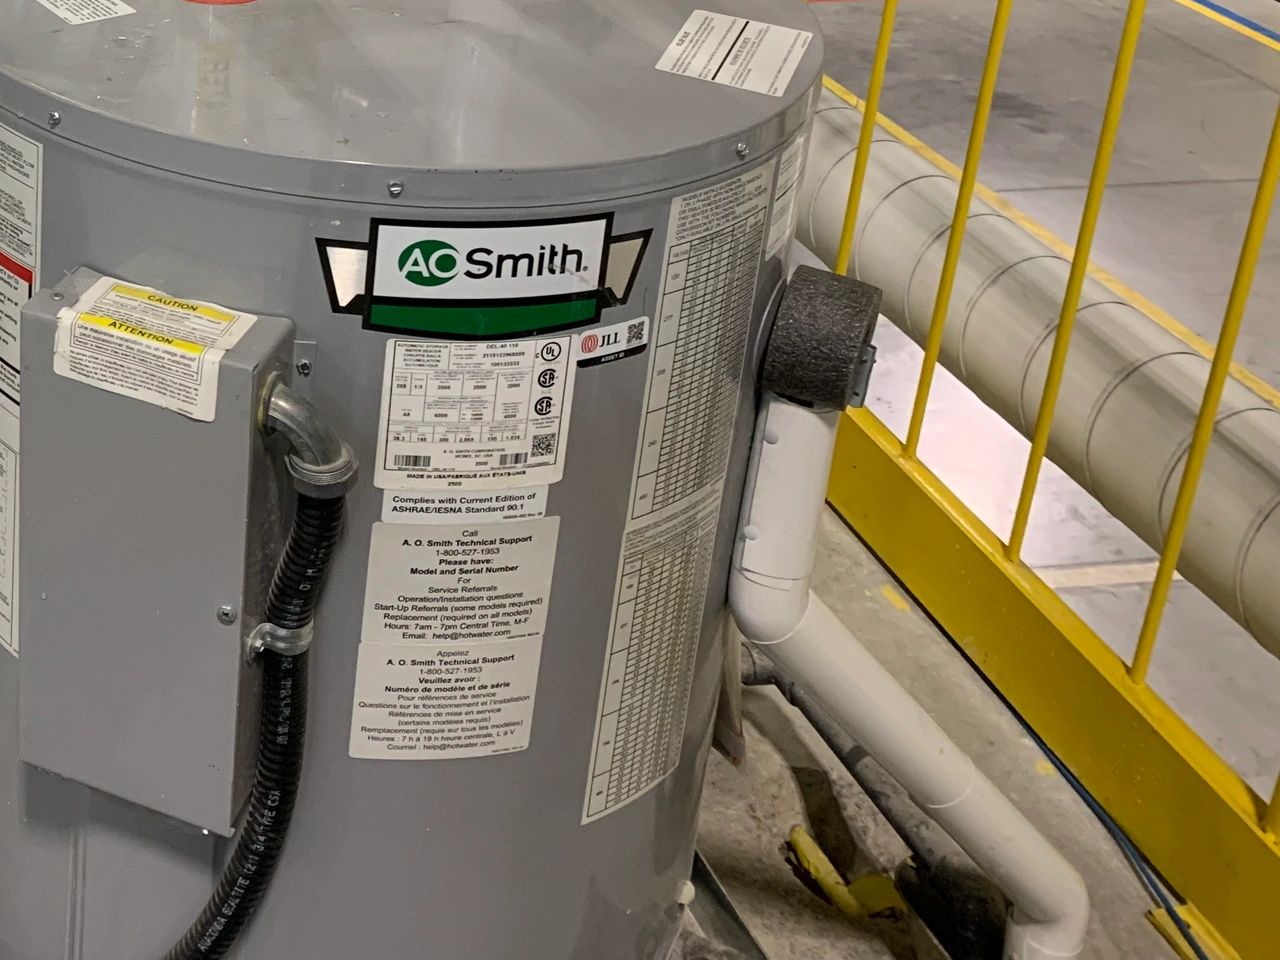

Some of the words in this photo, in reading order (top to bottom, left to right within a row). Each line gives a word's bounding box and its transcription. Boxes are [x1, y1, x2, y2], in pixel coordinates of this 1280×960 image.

[464, 243, 583, 280] Smith
[147, 294, 199, 312] CAUTION
[108, 321, 174, 344] ATTENTION
[599, 332, 620, 347] JLL
[393, 496, 436, 504] Complies
[465, 504, 504, 513] Standard
[499, 536, 532, 544] Support
[436, 548, 499, 556] 1-800-527-1953
[486, 565, 519, 573] Number
[462, 585, 497, 593] Referrals
[398, 595, 483, 603] Operation/Installation
[486, 591, 523, 600] questions
[374, 603, 409, 612] Start-Up
[451, 604, 475, 612] (some
[478, 602, 506, 610] models
[509, 598, 543, 607] required)
[384, 613, 438, 622] Replacement
[440, 613, 475, 622] (required
[491, 611, 499, 619] all
[502, 608, 532, 618] models)
[441, 623, 457, 631] 7pm
[460, 621, 489, 629] Central
[491, 620, 511, 629] Time,
[433, 629, 510, 640] help@hotwater.com
[437, 650, 469, 658] Appelez
[439, 657, 479, 665] Technical
[482, 655, 514, 664] Support
[478, 683, 488, 691] de
[359, 701, 397, 709] Questions
[423, 701, 478, 709] fonctionnement
[423, 740, 495, 750] help@hotwater.com
